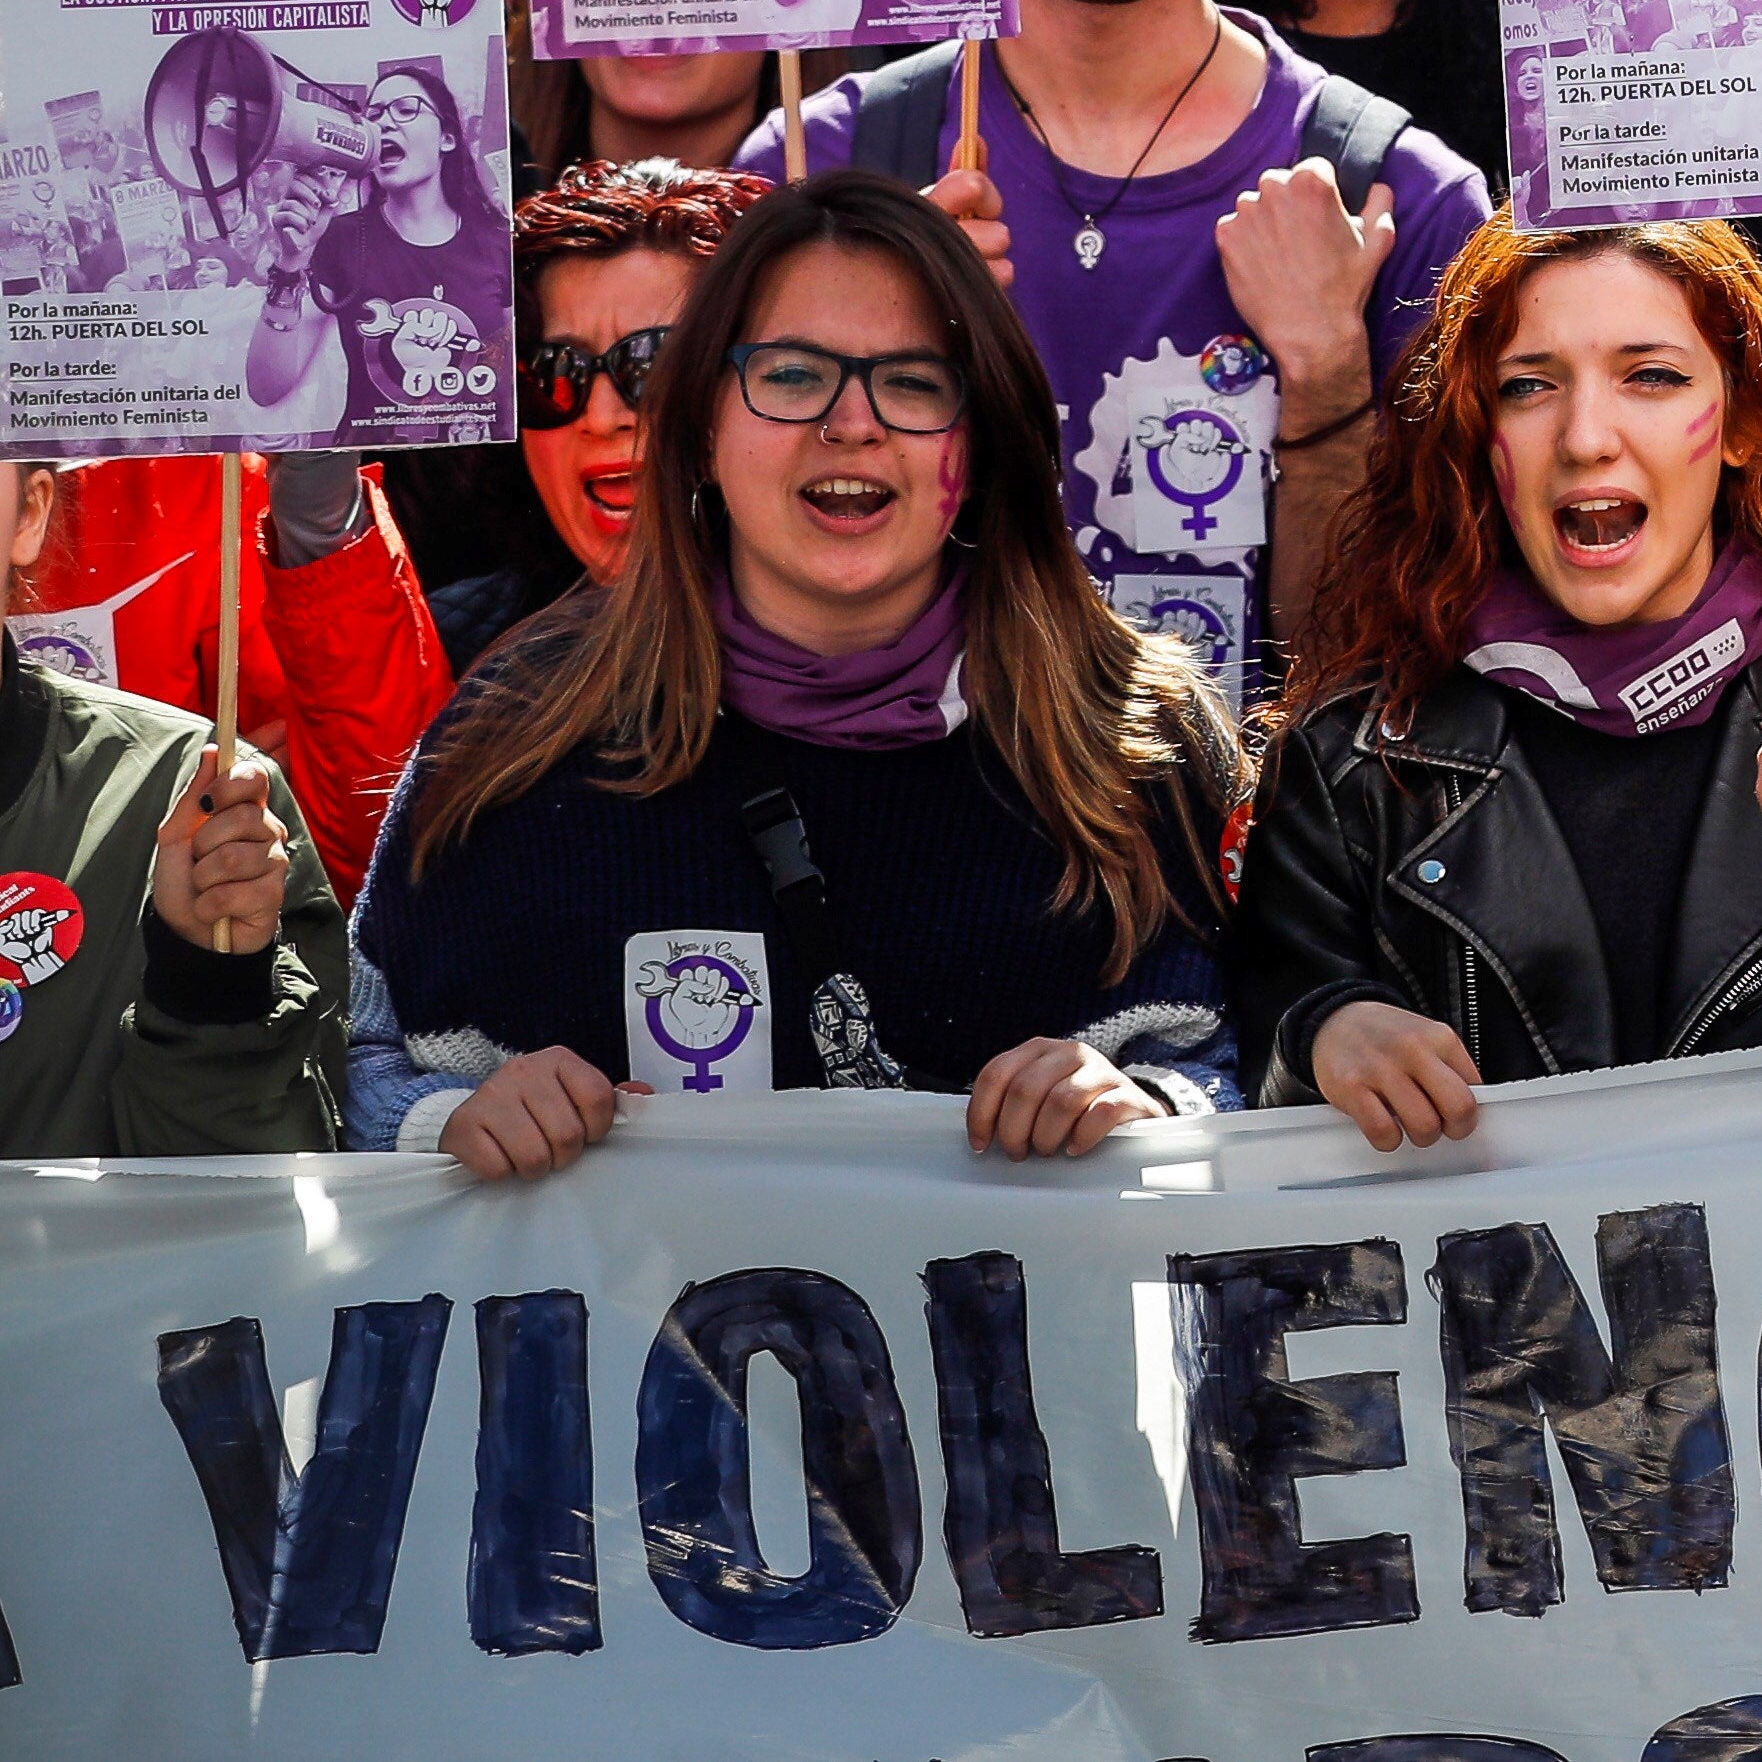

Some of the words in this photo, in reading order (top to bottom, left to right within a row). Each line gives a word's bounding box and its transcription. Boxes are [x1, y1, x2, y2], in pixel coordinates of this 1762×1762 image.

[1556, 66, 1587, 80] Por
[1591, 64, 1606, 79] la
[1611, 60, 1684, 78] mañana:
[1558, 87, 1595, 103] 12h.
[1602, 82, 1676, 101] PUERTA
[1680, 80, 1716, 96] DEL
[1720, 76, 1756, 93] SOL
[11, 388, 135, 404] Manifestación
[142, 385, 208, 402] unitaria
[214, 384, 239, 400] del
[11, 411, 117, 426] Movimiento
[124, 408, 207, 424] Feminista
[1628, 647, 1711, 713] CCOO
